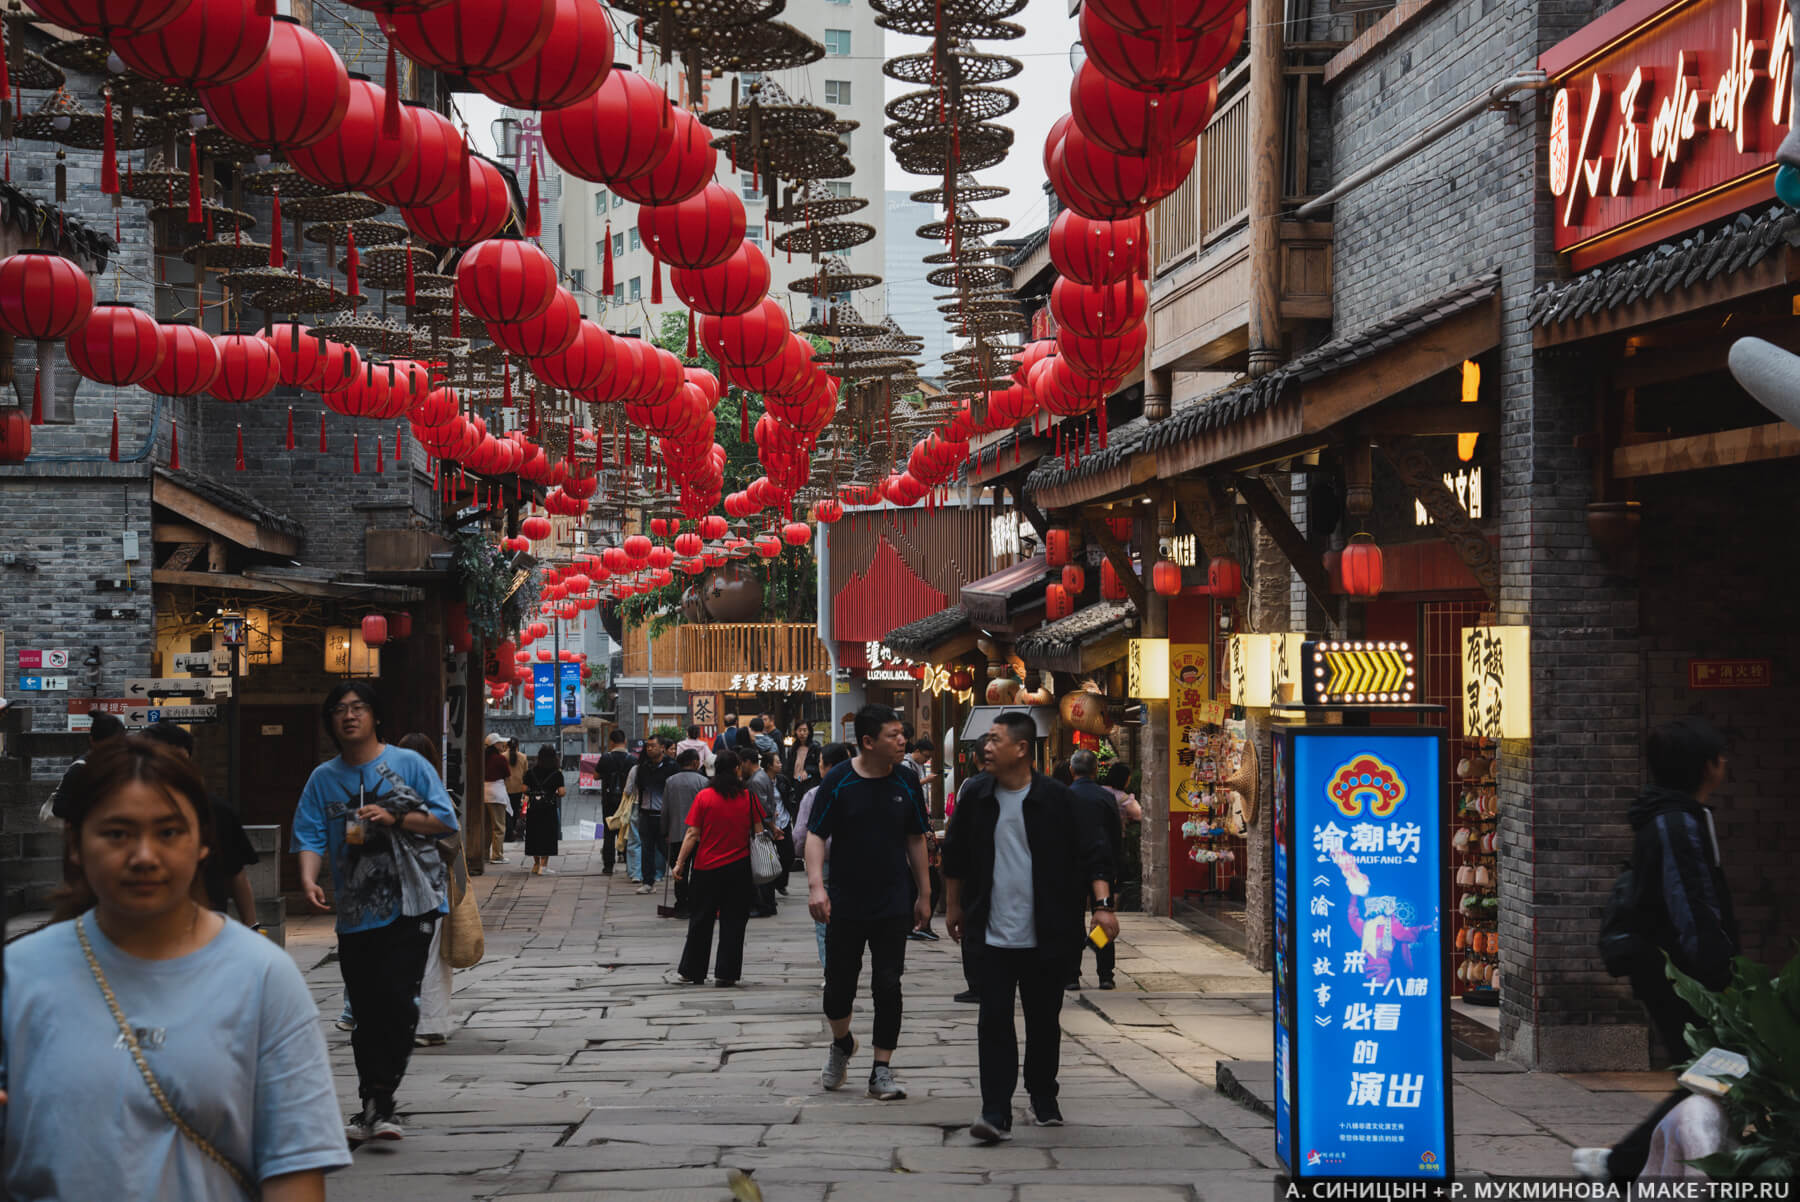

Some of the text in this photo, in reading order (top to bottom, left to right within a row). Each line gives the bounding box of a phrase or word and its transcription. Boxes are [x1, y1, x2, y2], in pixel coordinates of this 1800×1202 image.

[865, 671, 917, 681] LUZHOULAOJ
[695, 698, 713, 722] 茶
[1313, 821, 1421, 854] 渝潮坊
[1343, 950, 1366, 974] 来
[1362, 977, 1428, 996] 十八梯
[1342, 1002, 1401, 1031] 必看
[1352, 1040, 1378, 1064] 的
[1347, 1072, 1424, 1107] 演出
